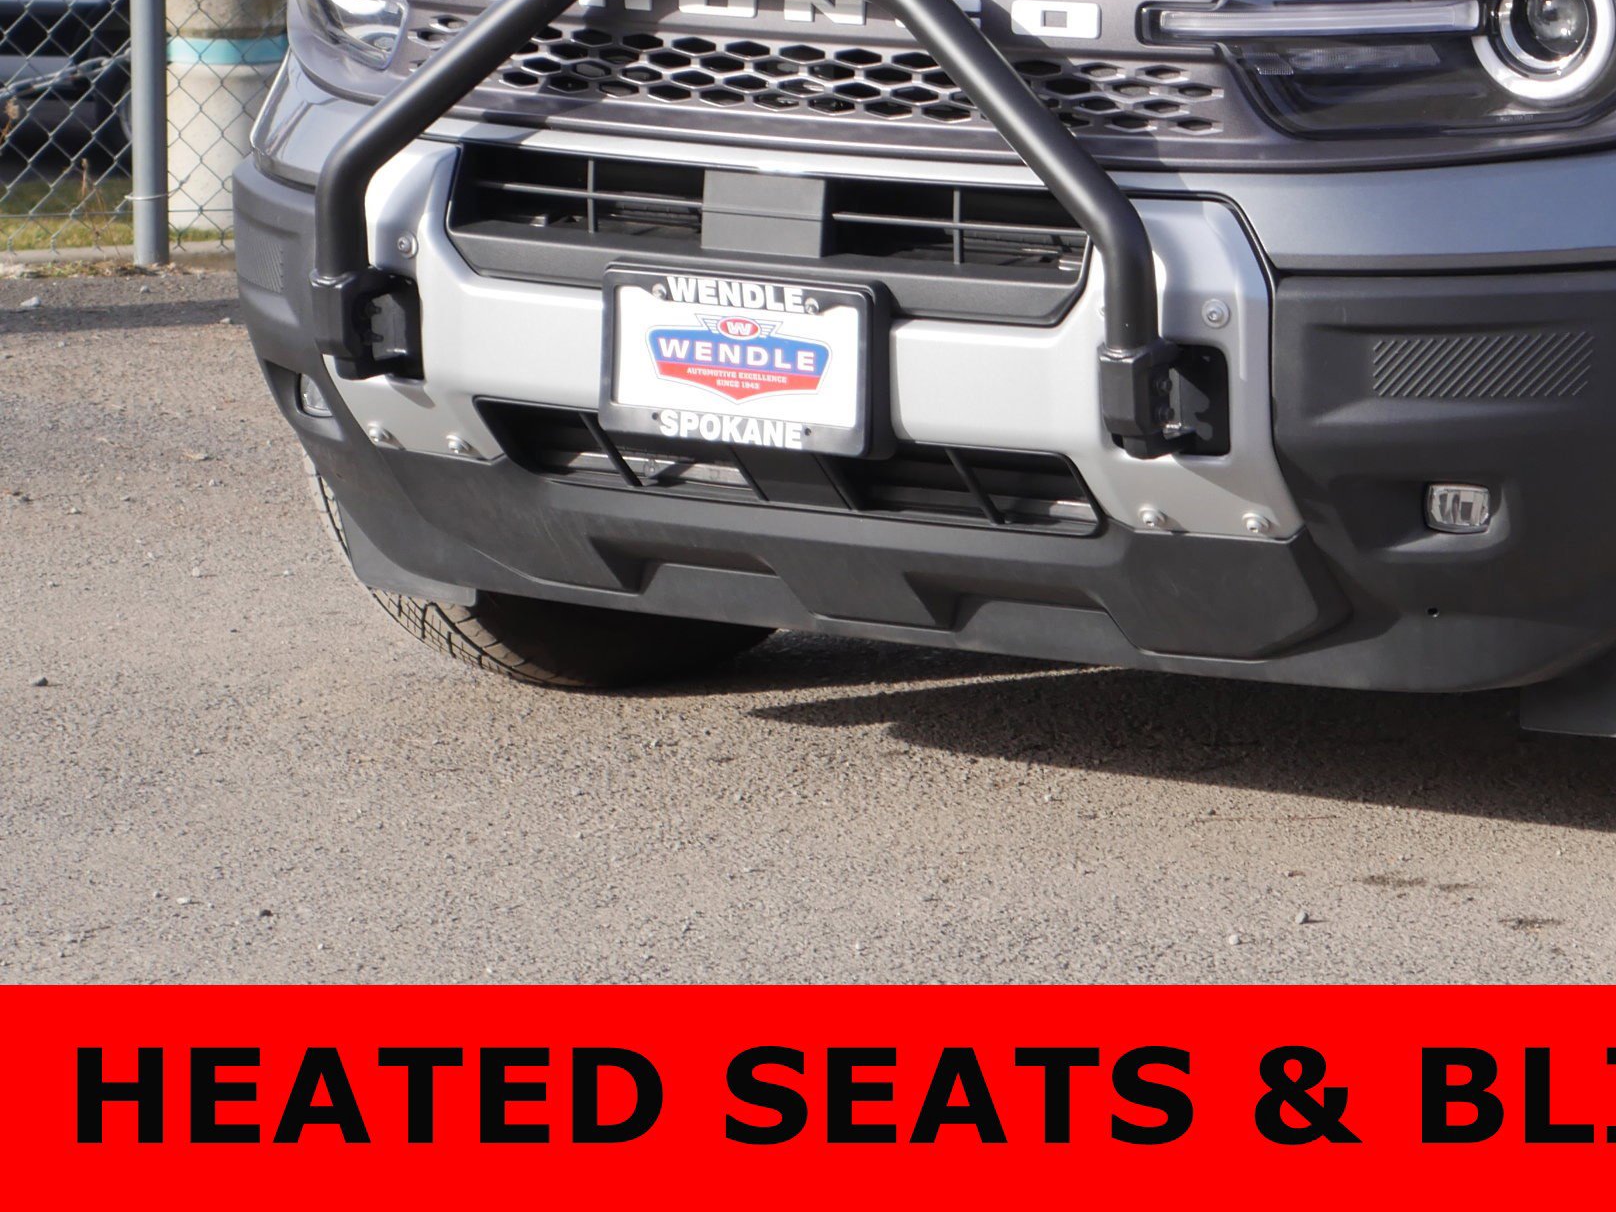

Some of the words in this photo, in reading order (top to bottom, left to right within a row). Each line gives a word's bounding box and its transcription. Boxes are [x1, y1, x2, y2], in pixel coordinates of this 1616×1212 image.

[667, 277, 805, 314] WENDLE
[658, 338, 815, 372] WENDLE
[687, 367, 737, 379] AUTOMOTIVE
[738, 371, 787, 384] EXCELLENCE
[716, 380, 739, 389] SINCE
[660, 410, 803, 450] SPOKANE
